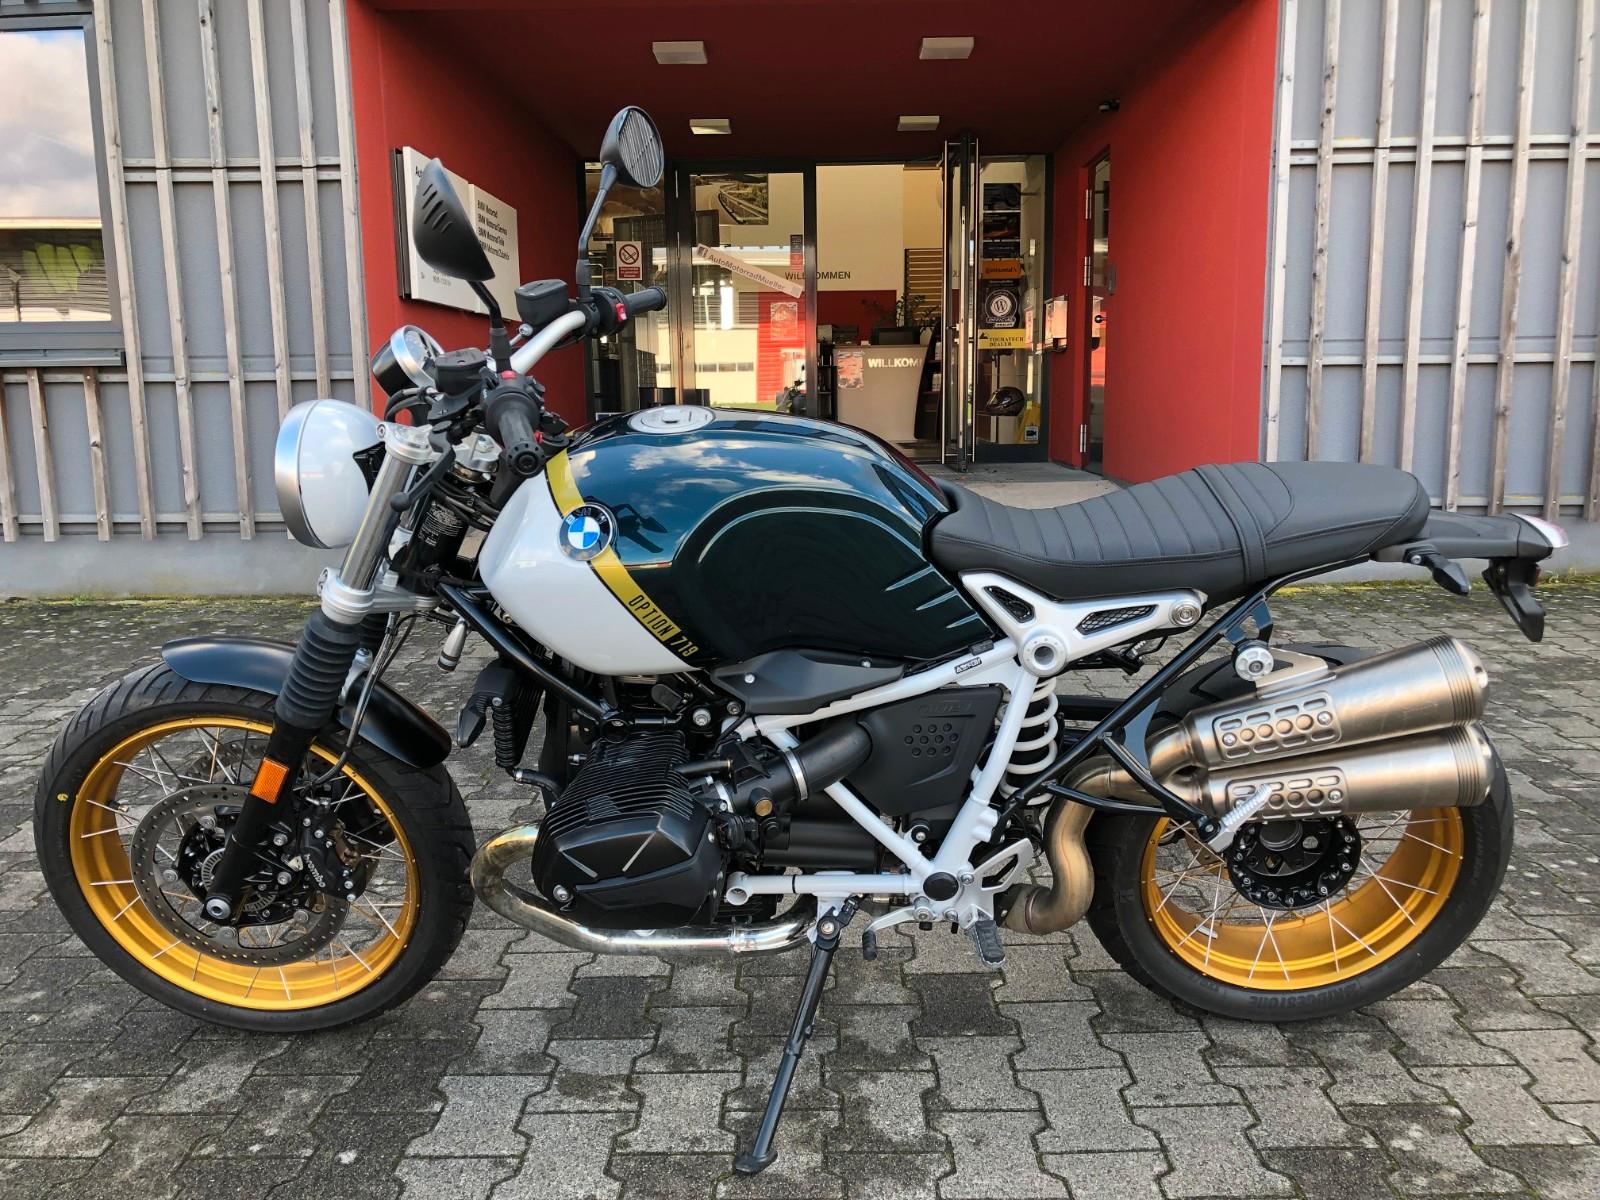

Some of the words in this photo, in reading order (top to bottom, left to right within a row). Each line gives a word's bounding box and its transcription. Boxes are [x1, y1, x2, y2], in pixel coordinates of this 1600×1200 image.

[708, 254, 785, 291] AutoMotorradMueller
[785, 271, 851, 281] WILLOMMEN
[565, 506, 608, 526] BMW
[628, 594, 675, 637] OPTION
[670, 635, 699, 657] 719
